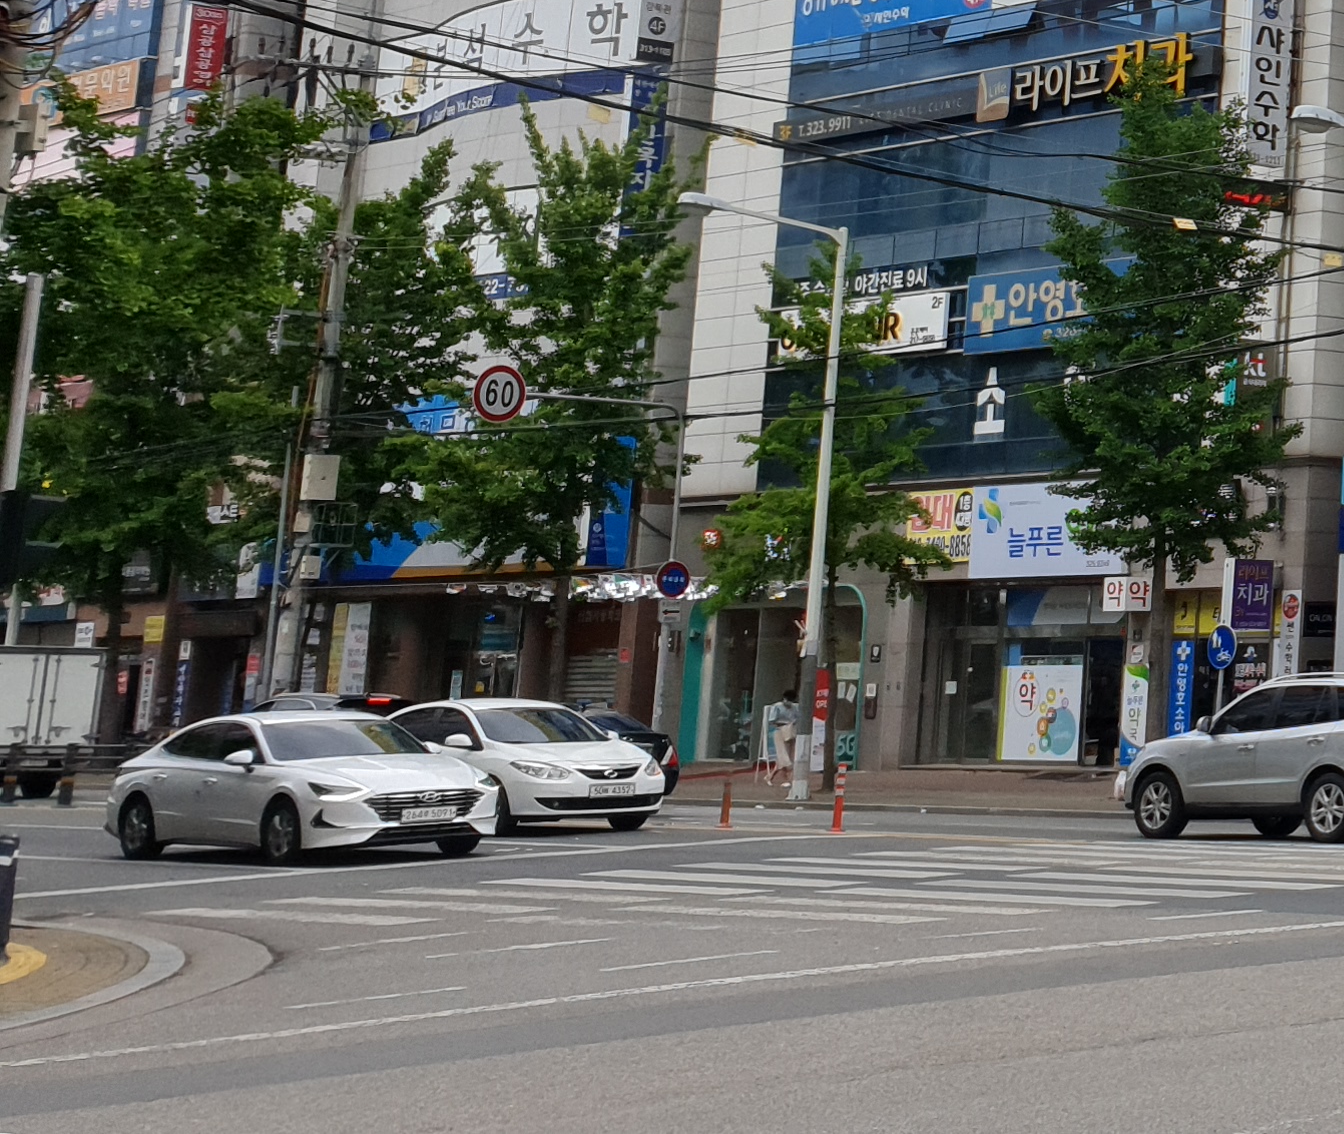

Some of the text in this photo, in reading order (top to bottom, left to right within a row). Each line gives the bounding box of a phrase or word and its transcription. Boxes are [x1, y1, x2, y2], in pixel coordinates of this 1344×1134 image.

[1253, 25, 1285, 152] 샤인수학
[798, 116, 851, 137] T.323.9911
[854, 270, 904, 296] 야간진료
[905, 266, 928, 288] 9시
[932, 296, 944, 310] 2F
[1244, 351, 1267, 377] kt
[485, 379, 514, 408] 60
[1007, 525, 1064, 558] 늘푸른
[1106, 580, 1124, 607] 약
[1129, 580, 1150, 608] 약
[1237, 582, 1270, 606] 치과
